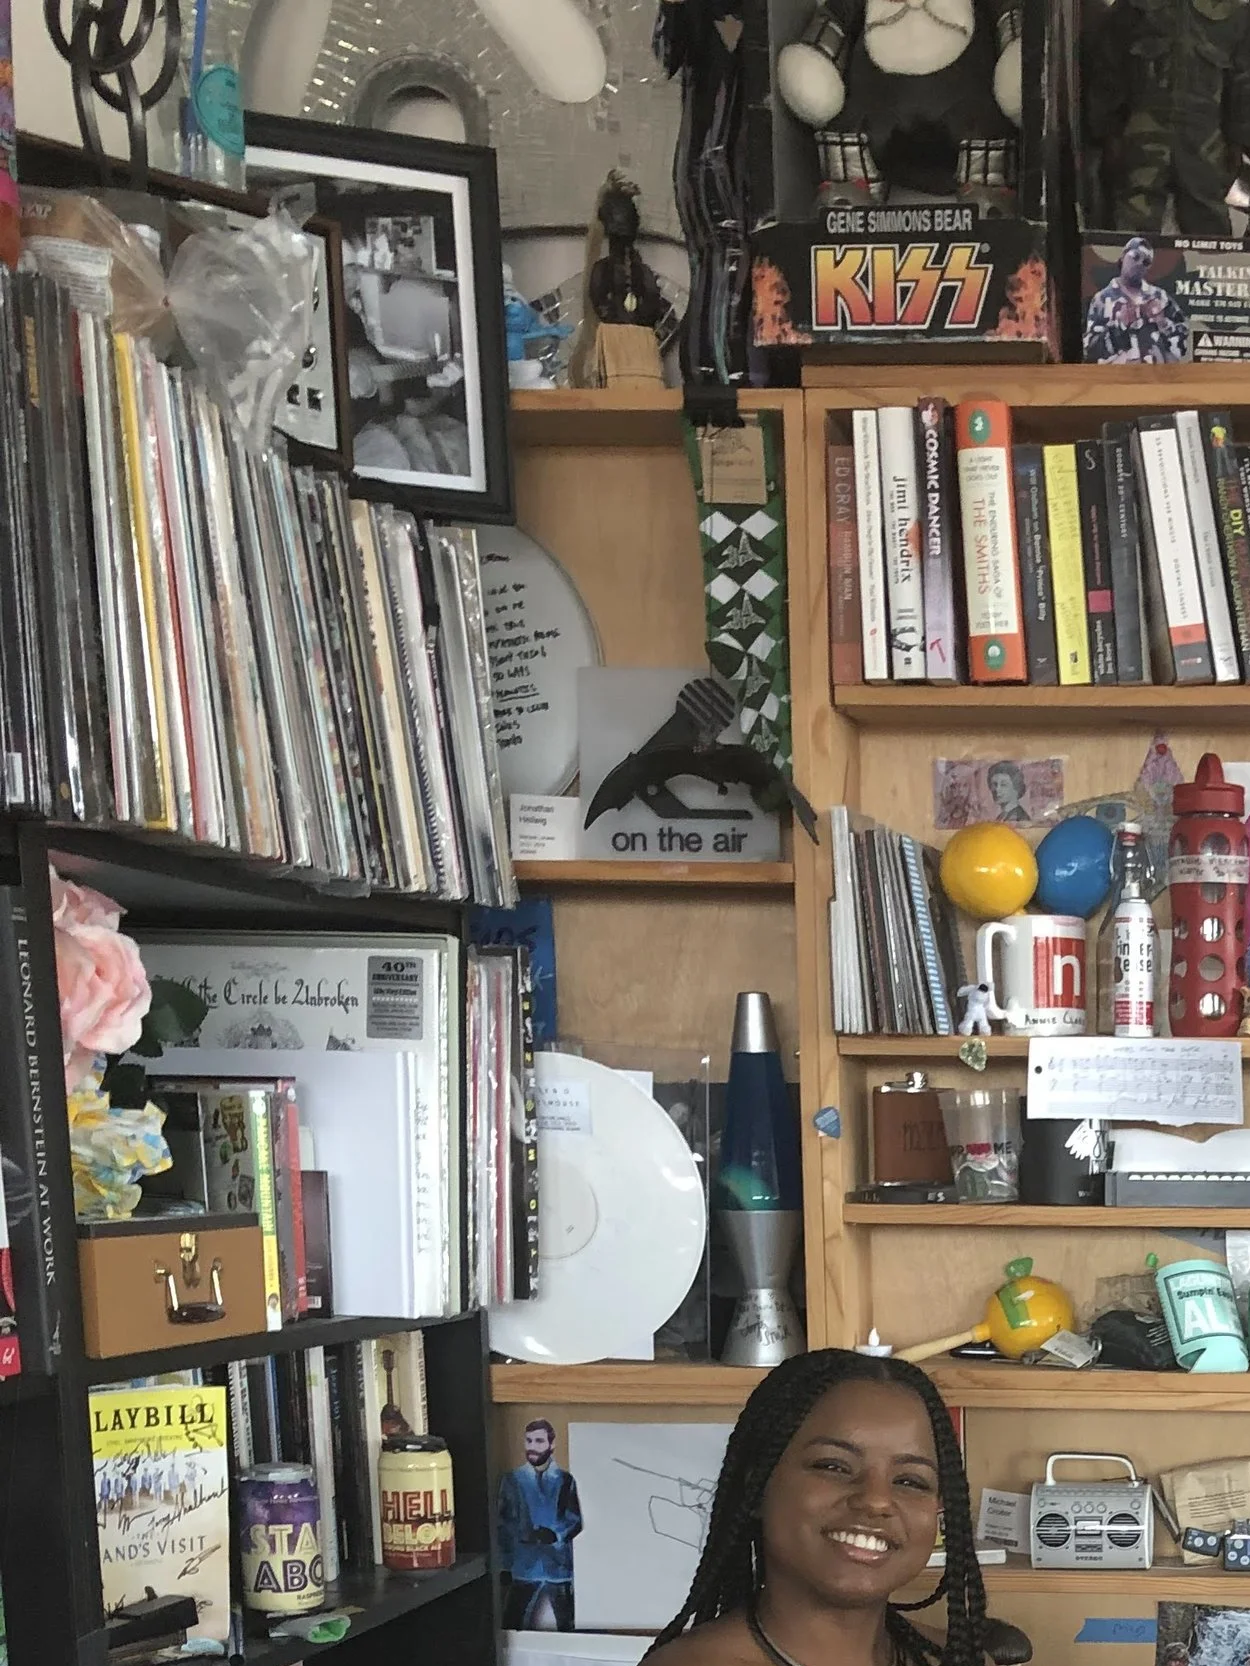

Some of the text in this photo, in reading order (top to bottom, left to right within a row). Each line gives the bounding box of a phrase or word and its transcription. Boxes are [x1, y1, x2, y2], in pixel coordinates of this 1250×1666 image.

[827, 210, 973, 233] GENE SIMMONS BEAR
[811, 242, 994, 330] KISS
[1175, 280, 1250, 297] MASTER
[925, 429, 941, 556] COSMIC DANCER
[892, 475, 913, 583] jimi hendrix
[1230, 509, 1246, 537] DIY
[972, 499, 990, 596] THE SMITHS
[611, 827, 748, 853] on the air
[223, 977, 359, 1014] Circle be Unbroken
[17, 938, 57, 1286] LEONARD BERNSTEIN AT WORK
[94, 1402, 214, 1433] LAYBILL
[382, 1489, 452, 1523] HELL
[157, 1535, 206, 1557] VISIT
[251, 1522, 321, 1556] STA
[383, 1521, 453, 1543] BELOW
